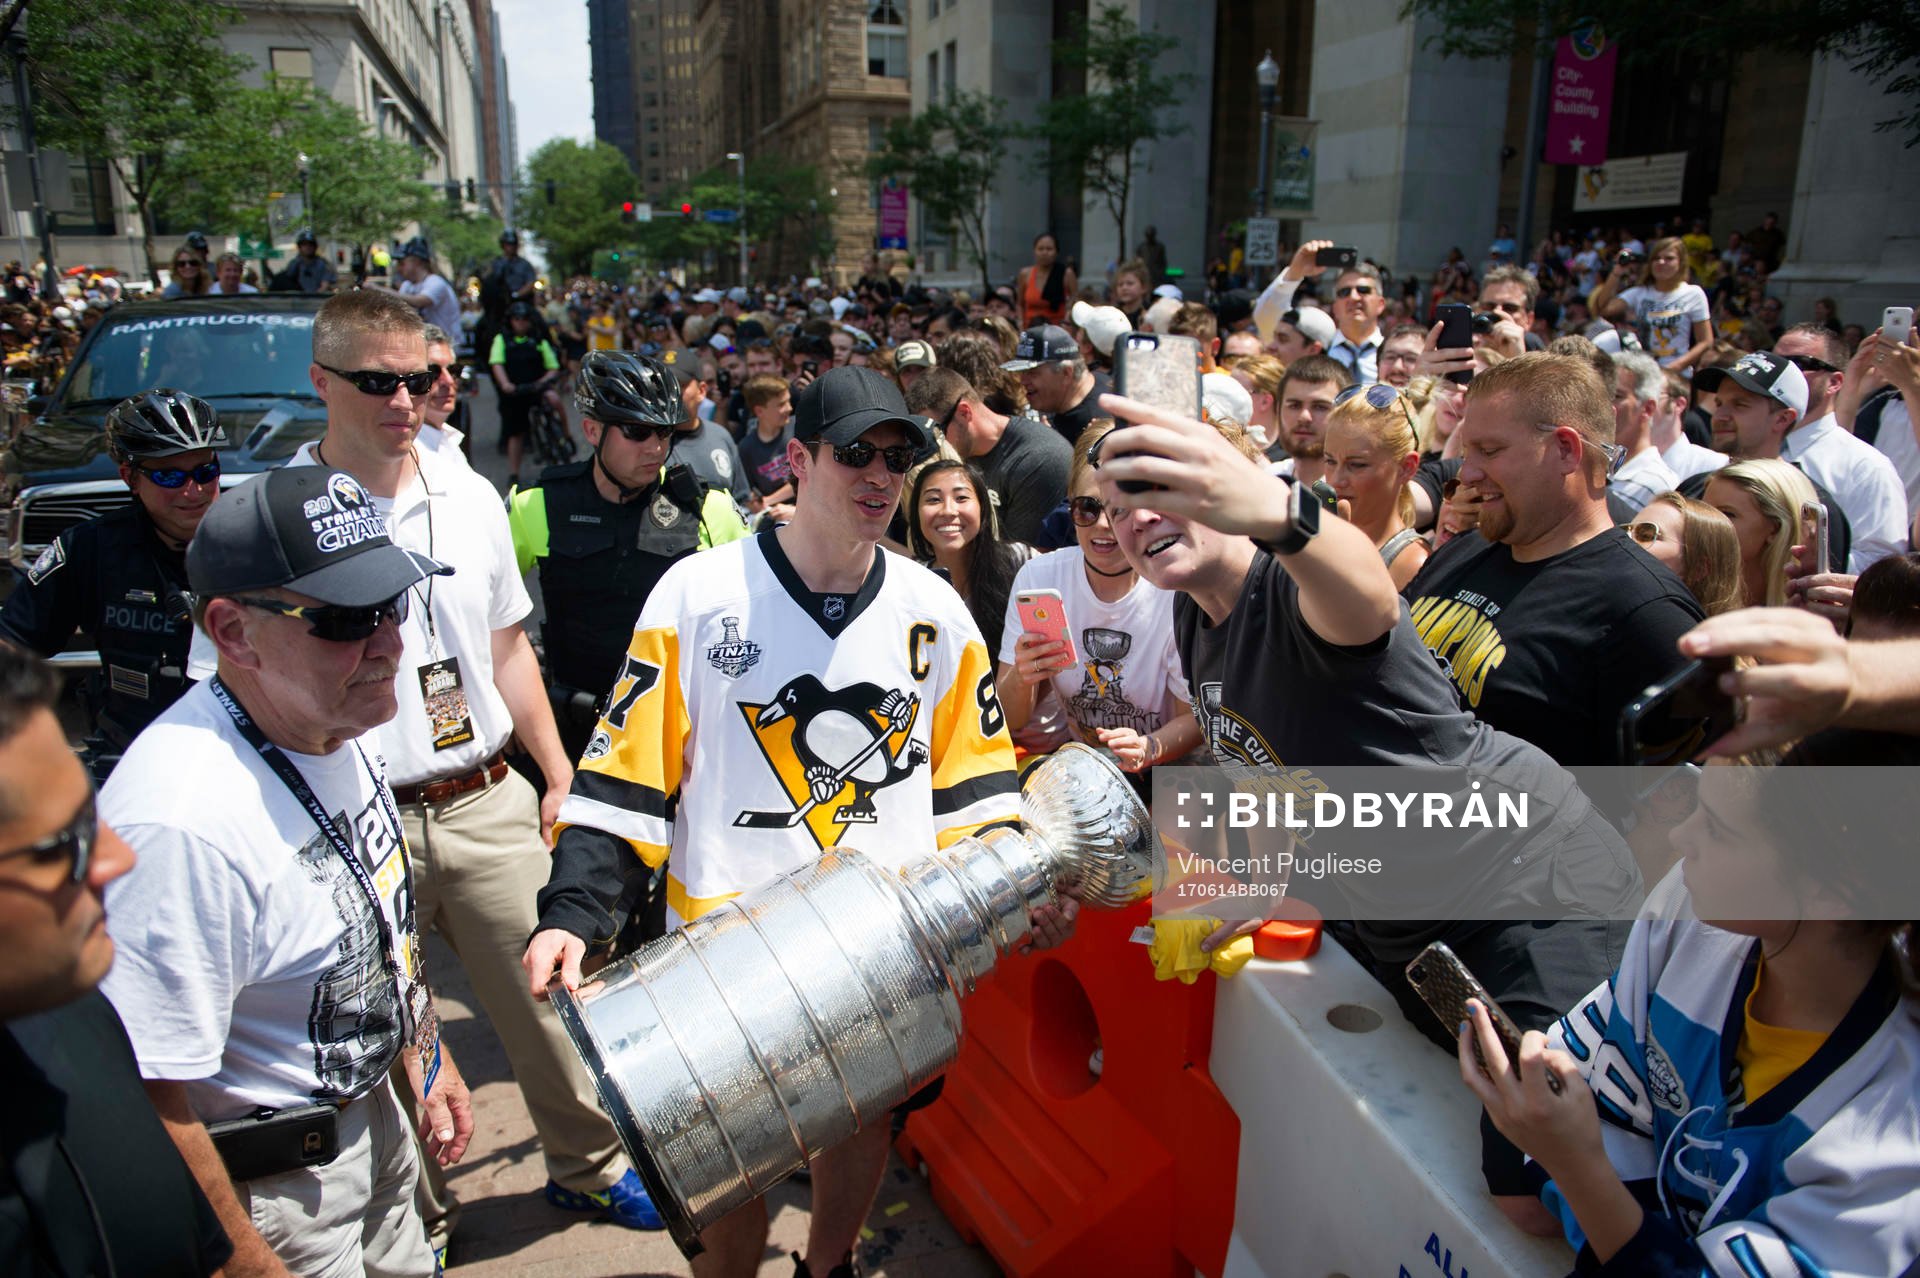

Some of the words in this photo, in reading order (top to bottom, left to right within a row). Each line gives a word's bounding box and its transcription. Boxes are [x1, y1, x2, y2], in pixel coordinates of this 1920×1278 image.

[1557, 67, 1583, 82] City-
[1555, 84, 1594, 99] County
[1554, 101, 1599, 119] Building
[1249, 241, 1274, 260] 25
[1454, 589, 1488, 607] STANLEY
[1484, 601, 1501, 617] CUP
[105, 605, 176, 633] POLICE
[708, 645, 762, 660] FINAL
[907, 621, 938, 682] C
[1244, 736, 1278, 772] CUP
[308, 800, 339, 839] FINAL
[335, 840, 356, 863] CUP
[351, 861, 380, 908] STANLEY
[1424, 1231, 1470, 1278] AL
